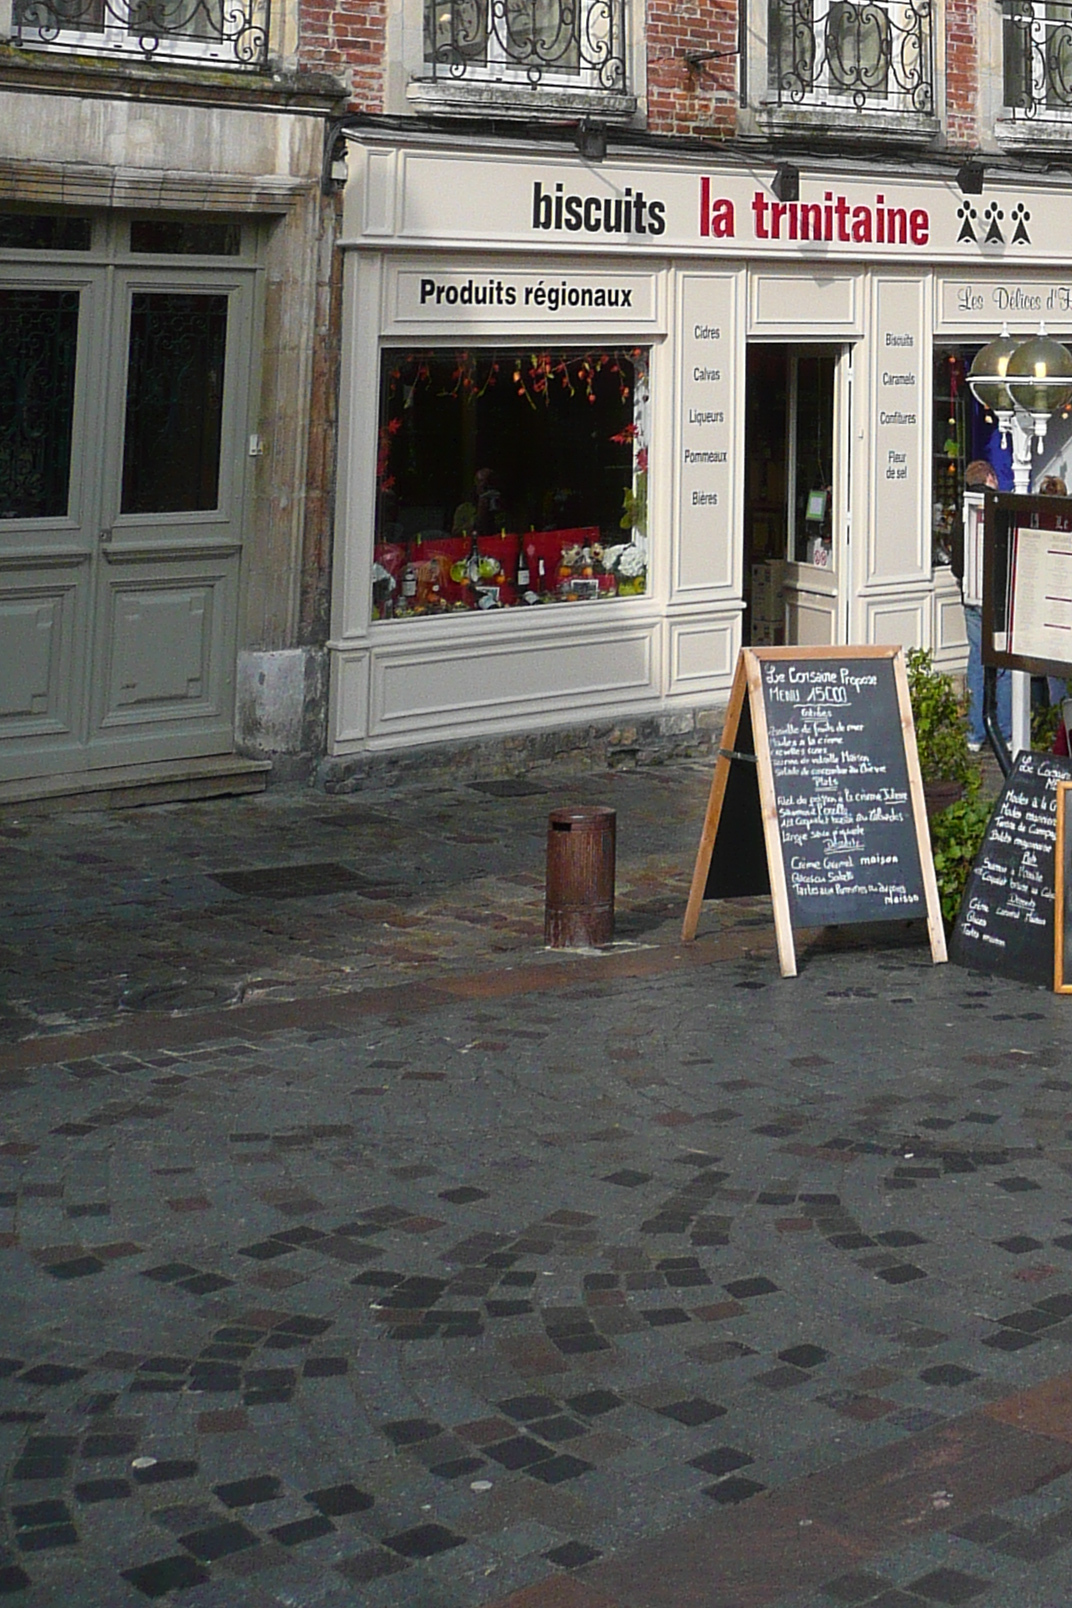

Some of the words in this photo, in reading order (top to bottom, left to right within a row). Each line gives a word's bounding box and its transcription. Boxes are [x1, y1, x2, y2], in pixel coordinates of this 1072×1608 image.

[532, 181, 666, 235] biscuits
[700, 177, 735, 239] la
[752, 190, 930, 245] trinitaine
[419, 278, 517, 306] Produits
[524, 280, 632, 311] régionaux
[957, 285, 983, 311] Les
[992, 286, 1041, 310] Délices
[694, 325, 720, 340] Cidres
[885, 333, 914, 346] Biscuits
[693, 366, 720, 381] Calvas
[883, 372, 916, 386] Caramels
[689, 408, 724, 426] Liqueurs
[880, 411, 916, 425] Confitures
[684, 449, 727, 463] Pommeaux
[888, 450, 906, 463] Fleur
[886, 466, 896, 479] de
[897, 466, 907, 479] sel
[692, 490, 718, 505] Bières
[1056, 515, 1069, 530] Le
[764, 664, 785, 683] Le
[840, 668, 877, 693] Propose
[769, 687, 799, 702] MENU
[860, 853, 898, 866] maison
